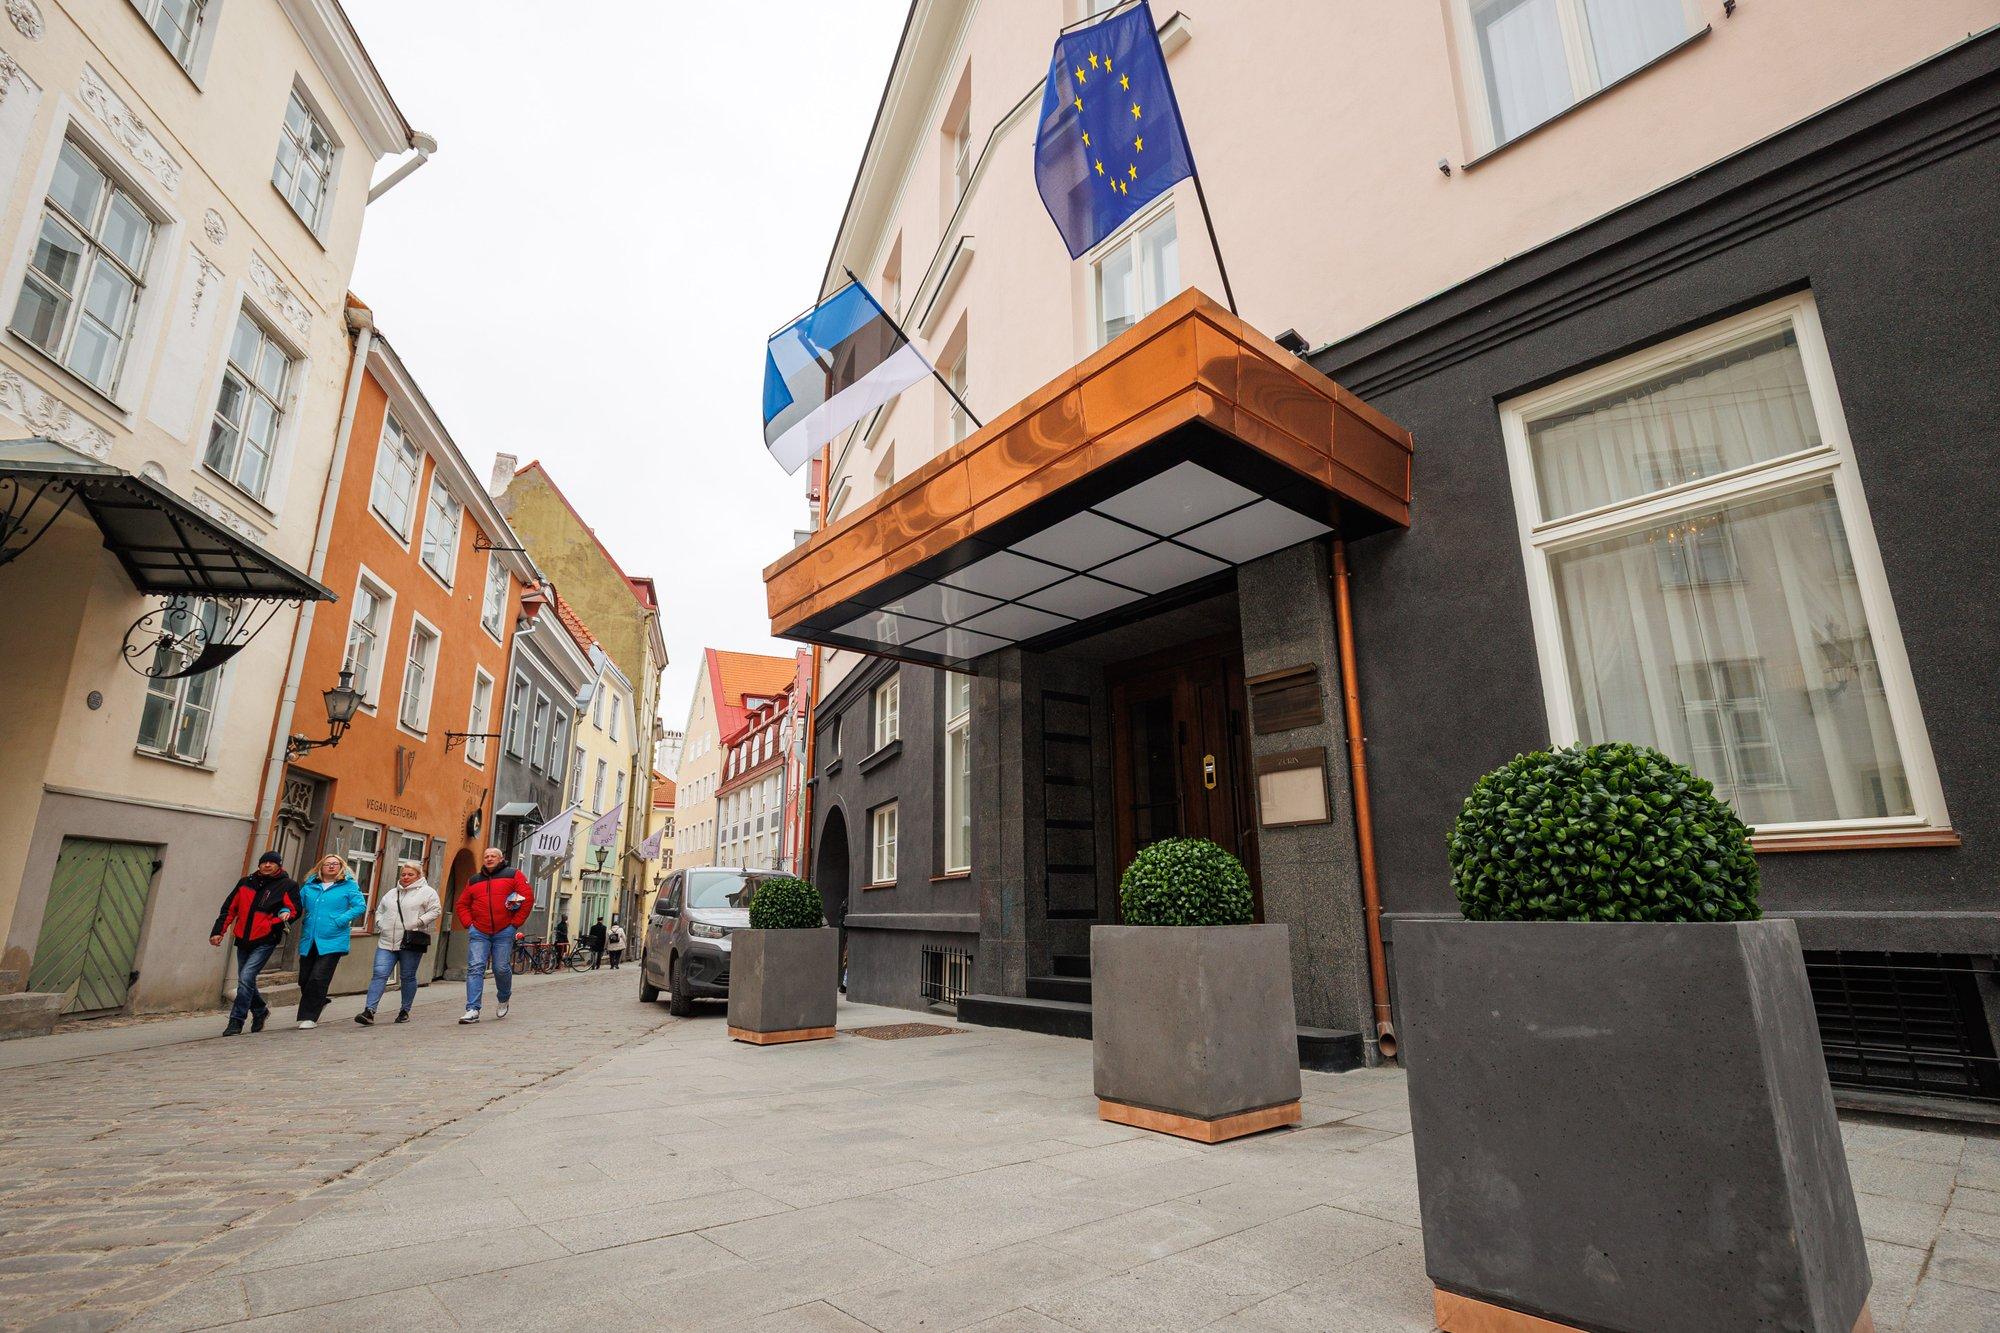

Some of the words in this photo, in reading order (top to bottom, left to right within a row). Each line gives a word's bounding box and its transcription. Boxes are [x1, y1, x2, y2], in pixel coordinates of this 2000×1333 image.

[366, 798, 387, 814] VEGAN
[389, 804, 418, 820] RESTORAN
[538, 833, 562, 851] H10
